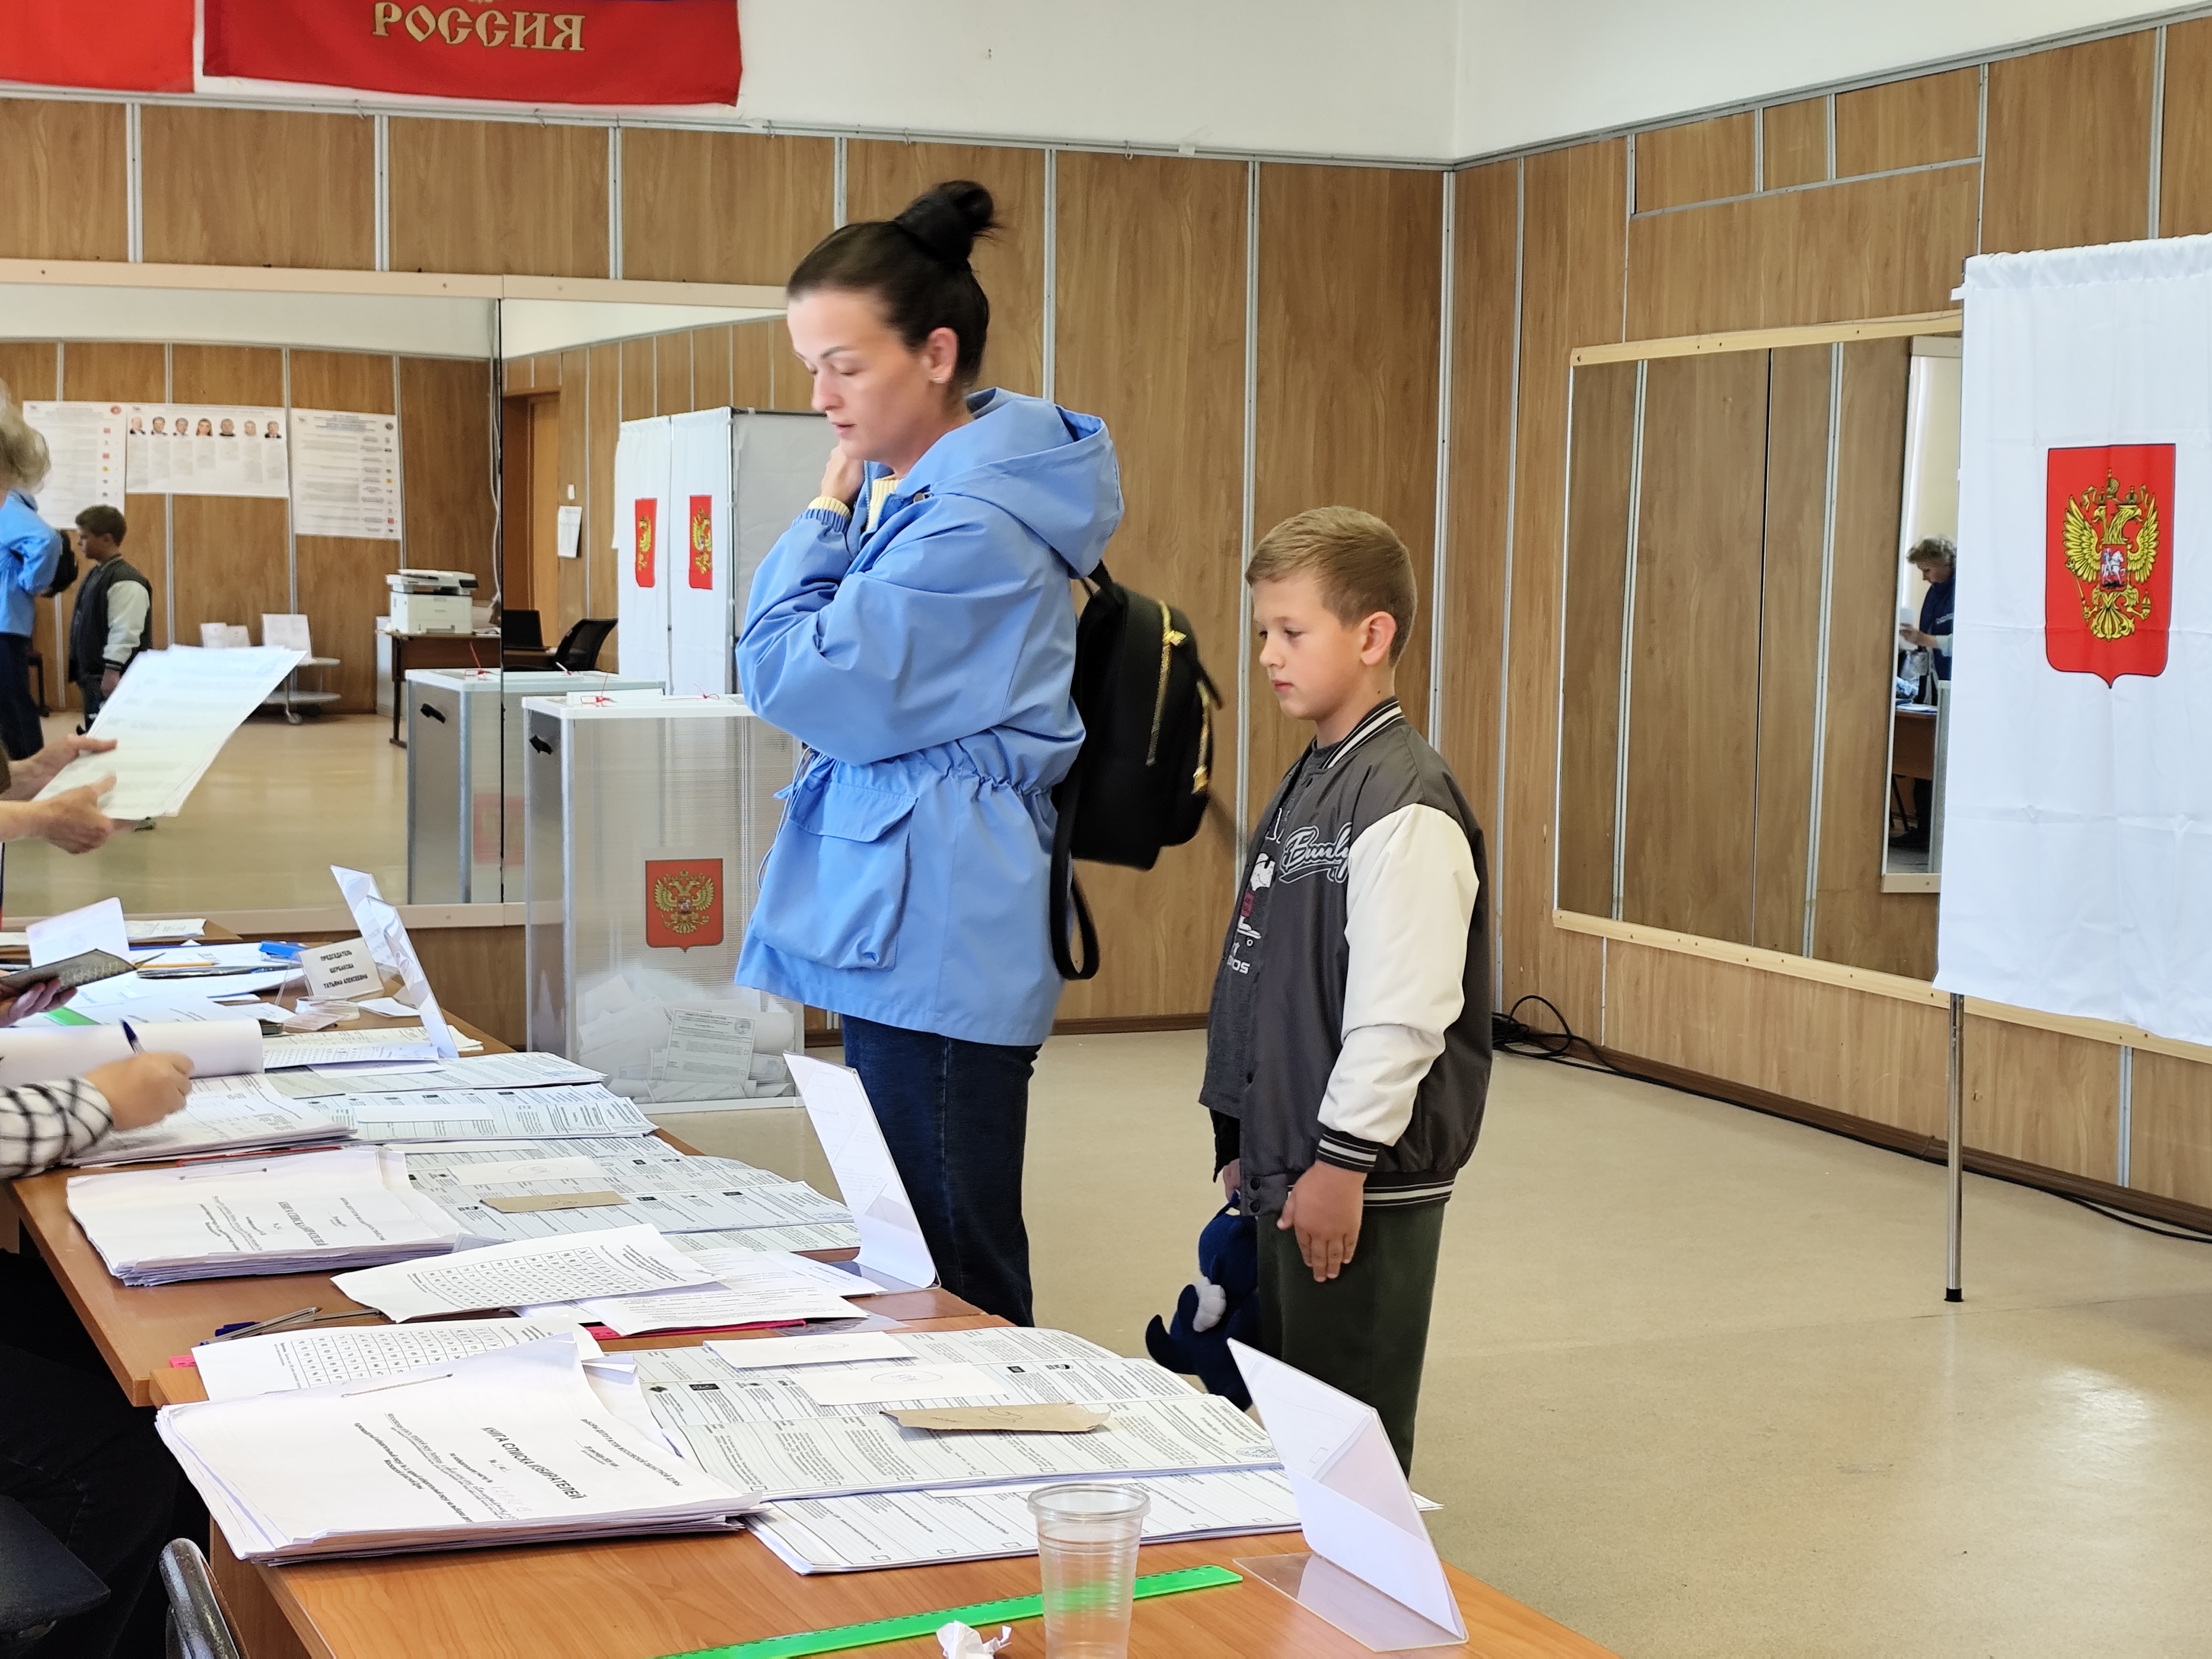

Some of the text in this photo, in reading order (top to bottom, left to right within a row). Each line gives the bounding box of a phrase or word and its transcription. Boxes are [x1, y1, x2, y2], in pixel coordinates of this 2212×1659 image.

[372, 1, 586, 52] РОССИЯ
[320, 950, 352, 961] ПРЕДСЕДАТЕЛЬ
[330, 963, 354, 973] ЩЕРБАКОВА
[324, 980, 343, 988] ТАТЬЯНА
[481, 1427, 510, 1442] КНИГА
[501, 1443, 535, 1464] СПИСКА
[526, 1464, 588, 1499] ИЗБИРАТЕЛЕЙ
